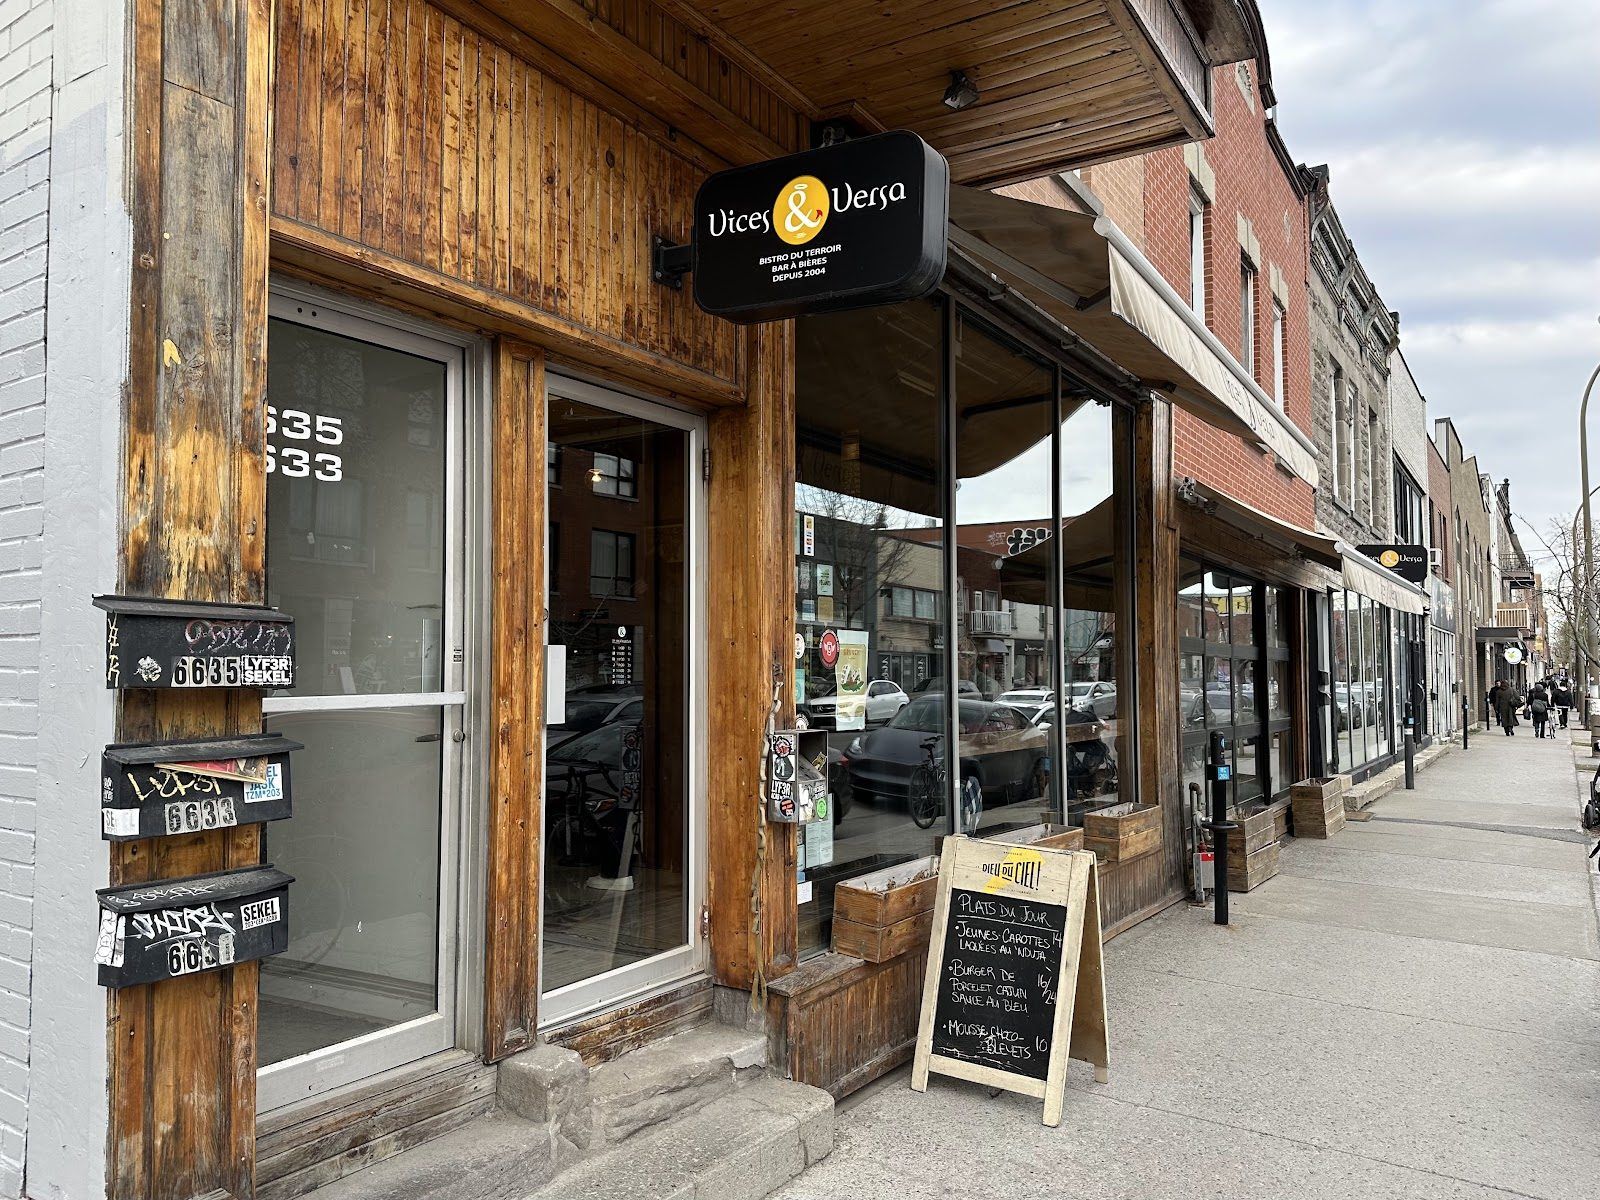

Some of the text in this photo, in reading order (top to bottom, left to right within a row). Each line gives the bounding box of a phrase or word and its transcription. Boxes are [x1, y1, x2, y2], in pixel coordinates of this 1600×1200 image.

[709, 182, 906, 237] Vices & Versa
[759, 244, 842, 266] BISTRO DU TERROIR
[771, 256, 828, 273] BAR À BIÈRES
[772, 266, 826, 283] DEPUIS 2004
[174, 656, 240, 685] 6635
[244, 658, 289, 671] LYF3R
[244, 670, 290, 684] SEKEL
[168, 797, 236, 833] 6633
[982, 863, 1001, 877] DIEU
[1002, 866, 1014, 878] DU
[1014, 861, 1041, 891] CIEL!
[243, 900, 277, 922] SEKEL
[958, 893, 1053, 927] PLATS DU JOUR
[957, 920, 1063, 949] JEUNES CAROTTES 14
[999, 945, 1012, 955] AU
[951, 958, 996, 980] BURGER
[1000, 968, 1016, 982] DE
[949, 977, 1028, 1000] PORCELET CAJUN
[952, 991, 1028, 1013] SAUCE AU BLEU
[948, 1019, 988, 1037] MOUSSE
[1035, 1035, 1048, 1052] 10
